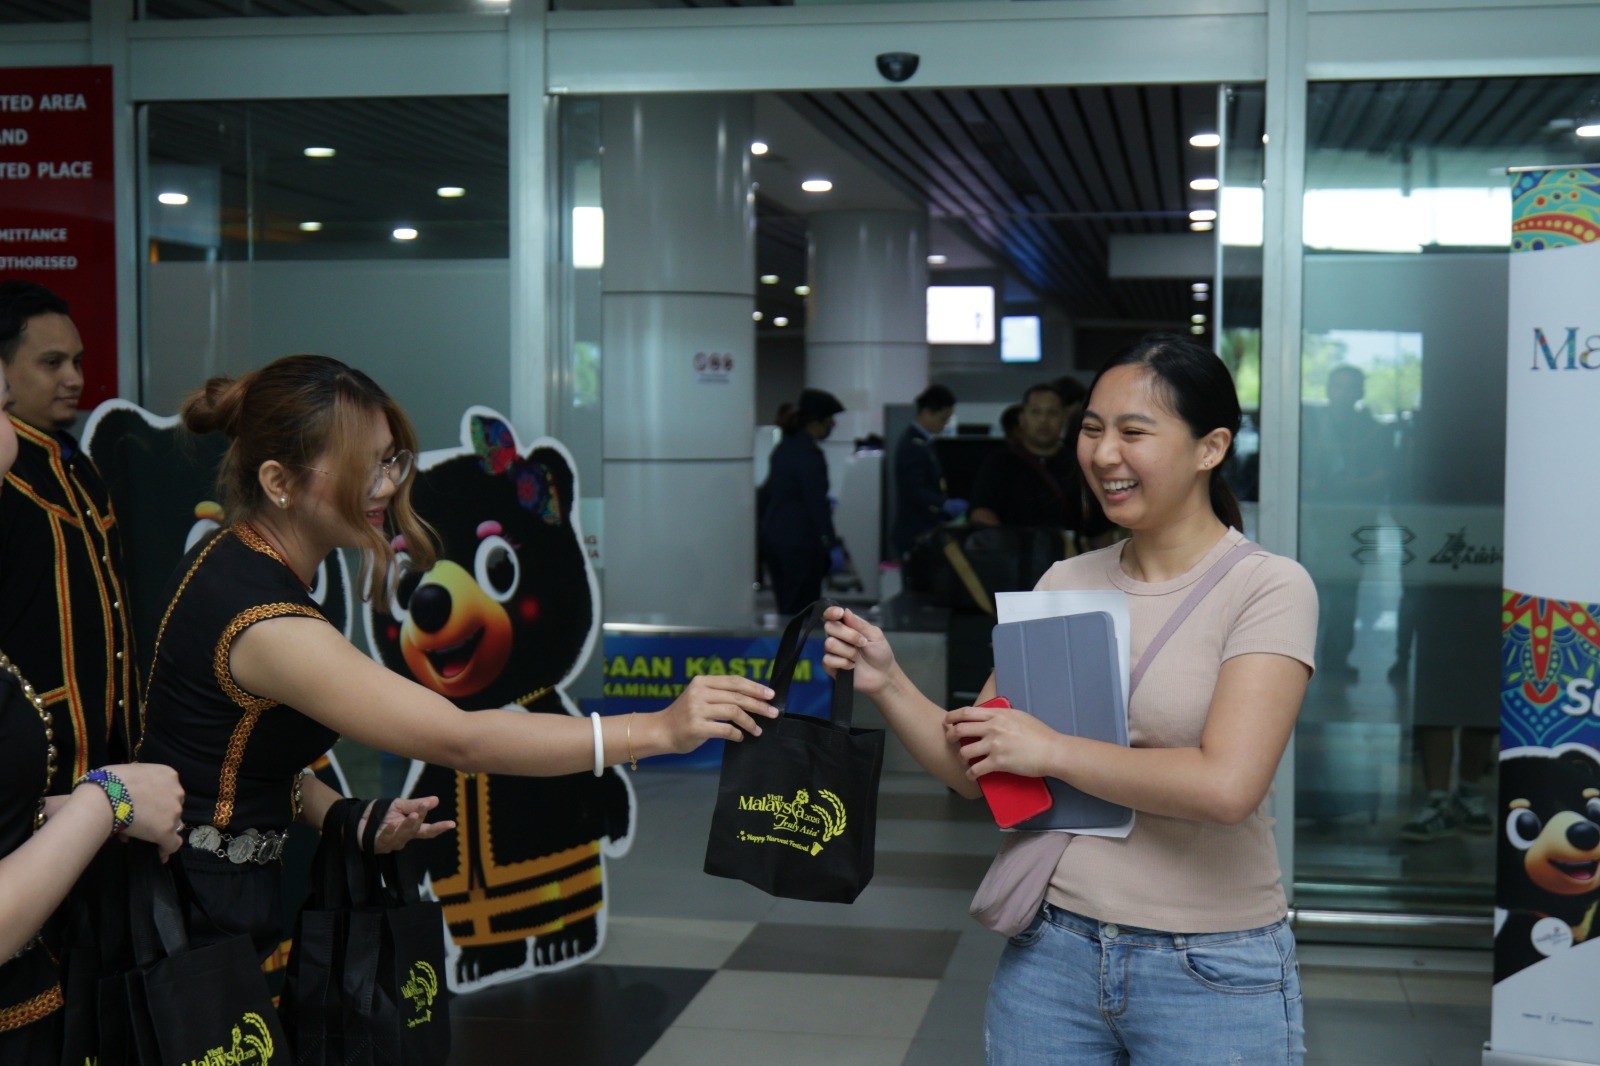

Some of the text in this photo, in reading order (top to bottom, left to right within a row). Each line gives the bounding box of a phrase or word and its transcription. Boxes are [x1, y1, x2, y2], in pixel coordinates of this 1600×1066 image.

[39, 94, 86, 110] AREA
[37, 162, 92, 178] PLACE
[604, 656, 673, 679] AAN
[1561, 678, 1600, 717] S
[767, 793, 784, 802] Visit
[800, 826, 819, 837] Asia
